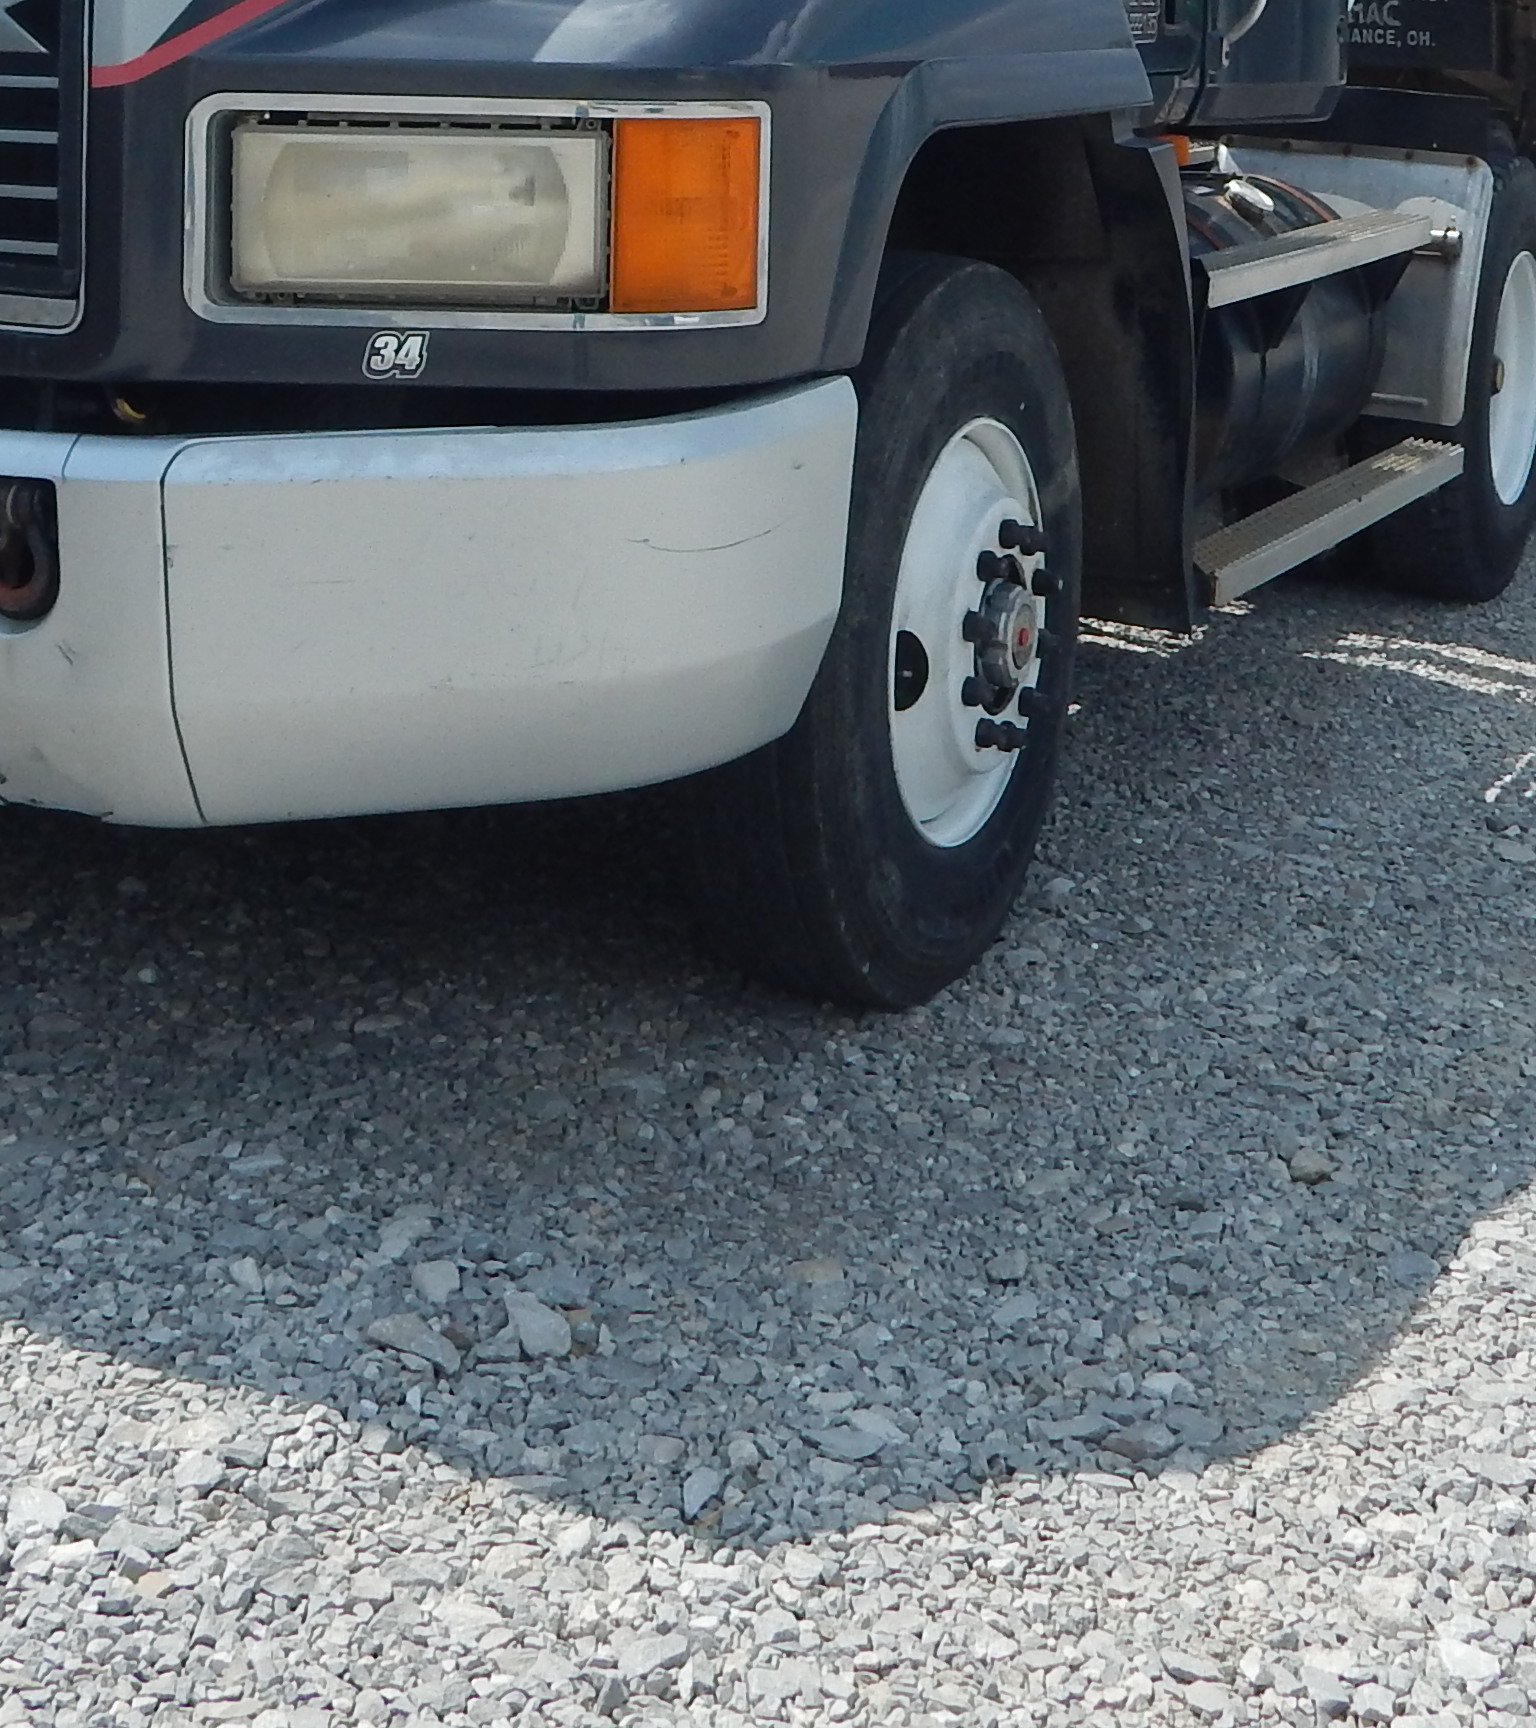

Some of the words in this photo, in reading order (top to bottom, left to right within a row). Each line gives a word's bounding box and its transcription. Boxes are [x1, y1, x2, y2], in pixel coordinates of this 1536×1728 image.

[1350, 28, 1402, 48] ANCE,
[1406, 30, 1436, 46] OH.
[366, 333, 425, 375] 34
